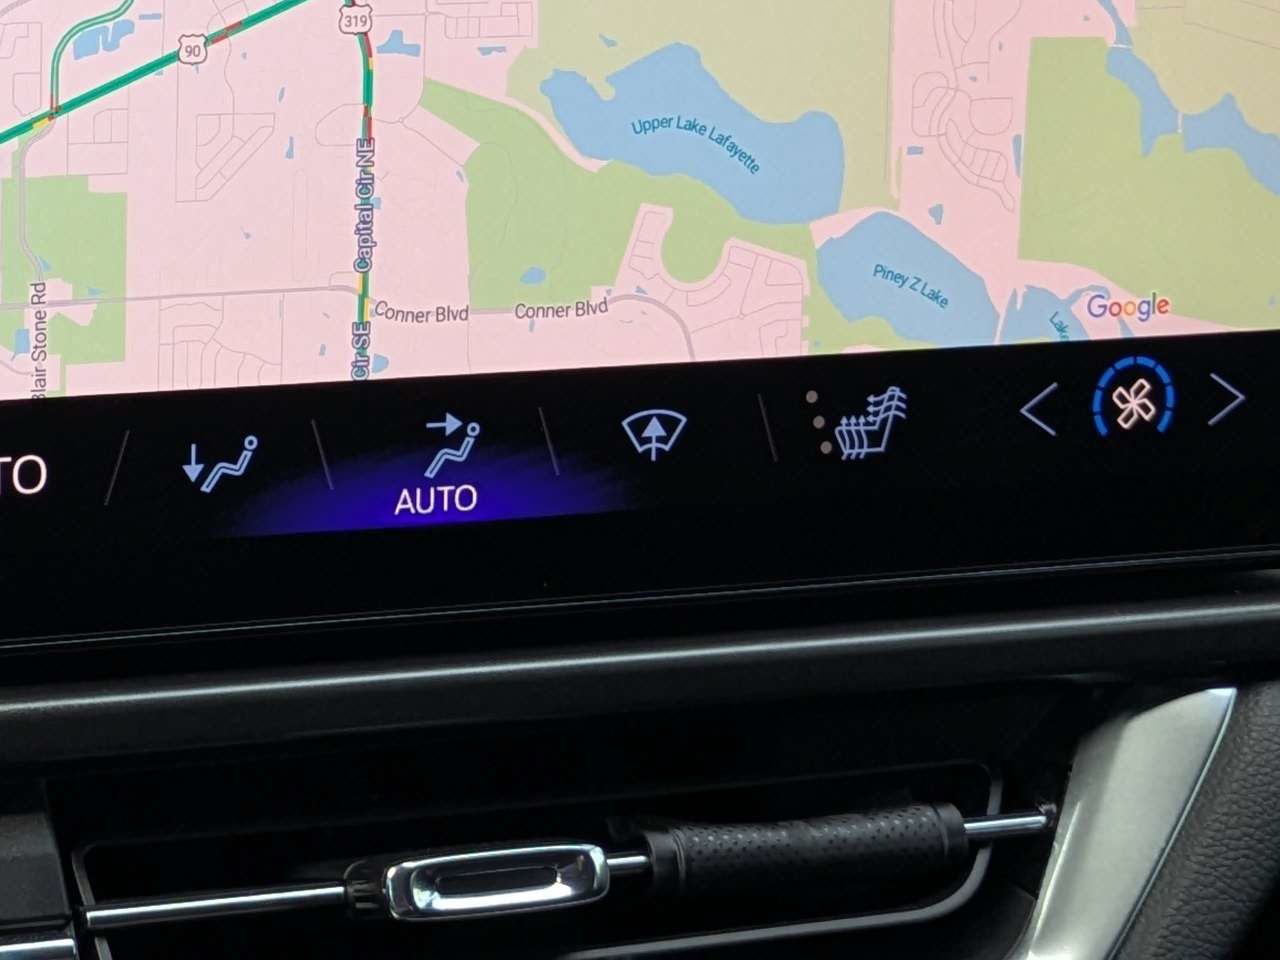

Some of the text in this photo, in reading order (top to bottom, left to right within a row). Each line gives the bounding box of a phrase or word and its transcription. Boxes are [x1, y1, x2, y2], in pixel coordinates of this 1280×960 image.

[344, 15, 368, 28] 319
[185, 45, 200, 58] 90
[632, 115, 760, 175] Upper Lake Lafayette
[354, 138, 376, 273] Capital Cir NE
[30, 282, 46, 305] Rd
[873, 264, 949, 309] Piney Z Lake
[375, 300, 469, 323] Conner Blvd
[515, 298, 608, 321] Conner Blvd
[1087, 292, 1170, 321] Google
[31, 310, 47, 362] Stone
[351, 322, 370, 380] Cir SE
[395, 484, 478, 515] AUTO
